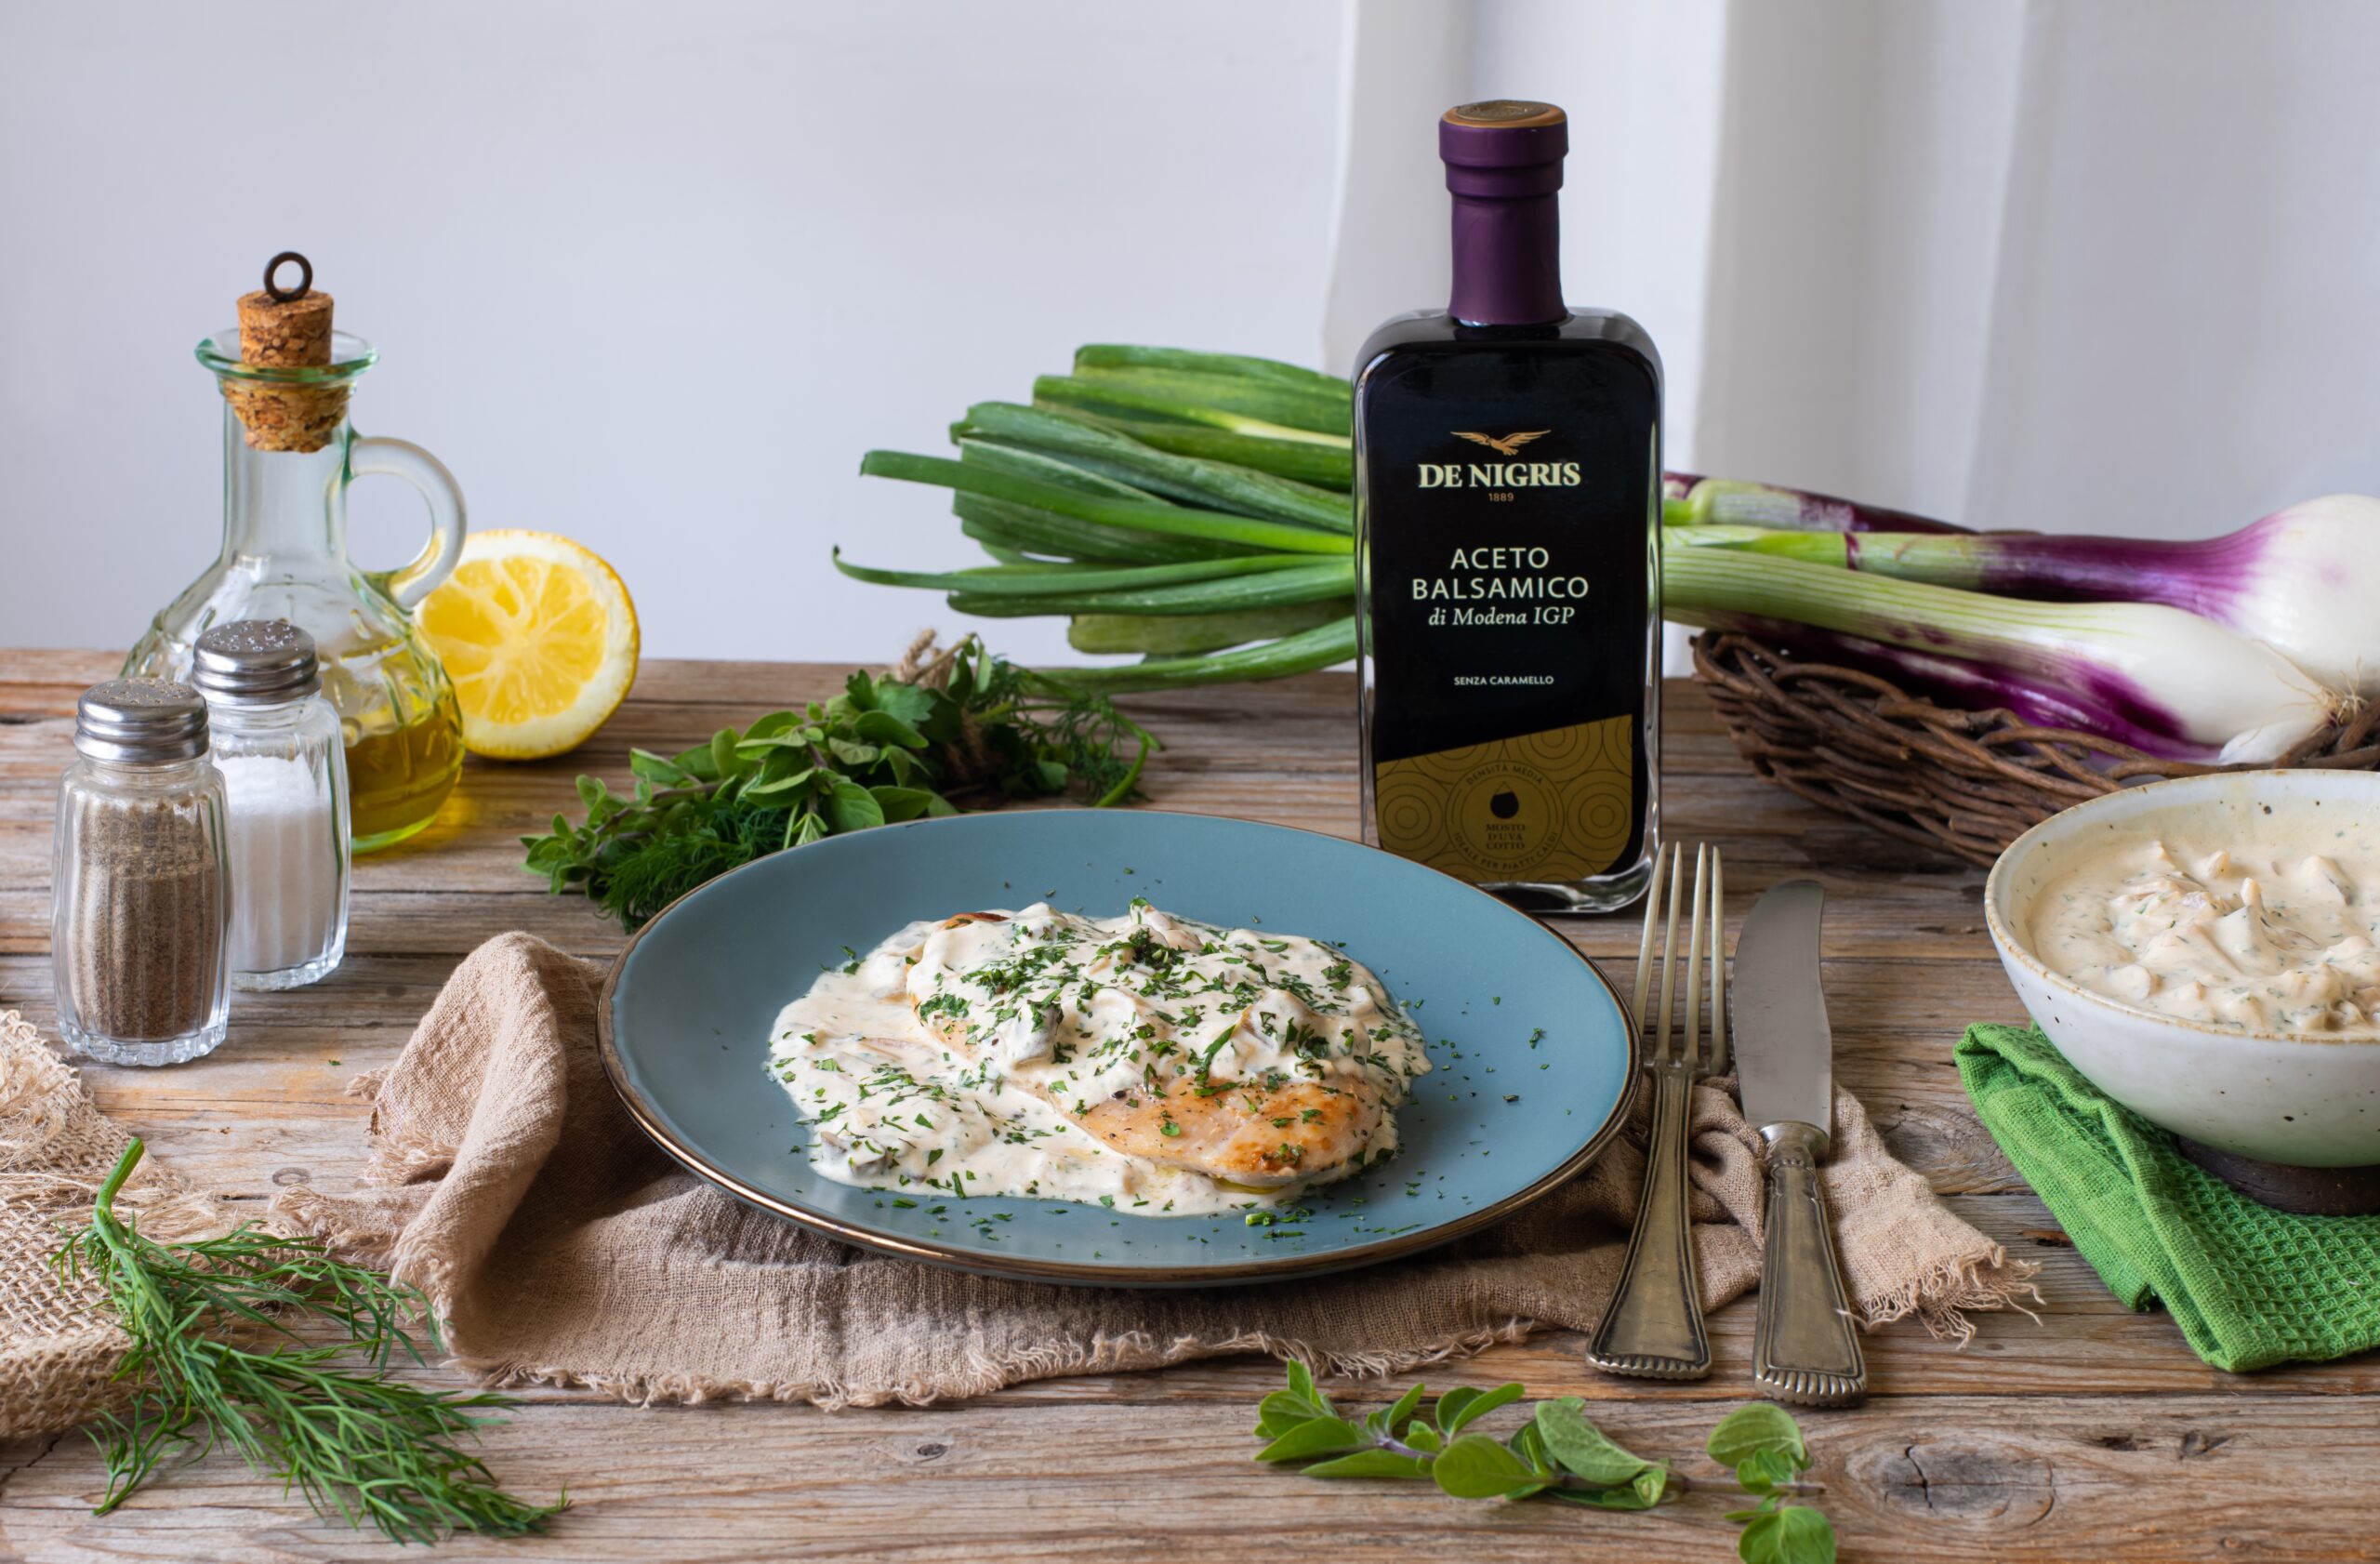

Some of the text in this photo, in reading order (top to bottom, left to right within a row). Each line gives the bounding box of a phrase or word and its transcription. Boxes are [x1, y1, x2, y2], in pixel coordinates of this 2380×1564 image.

[1418, 462, 1581, 487] DE NIGRIS
[1488, 493, 1514, 502] 1889
[1450, 547, 1550, 570] ACETO
[1412, 577, 1589, 600] BALSAMICO
[1428, 606, 1576, 626] di Modena IGP
[1454, 675, 1554, 686] SENZA CARAMELLO
[1466, 762, 1544, 786] DENSITÀ MEDIA
[1486, 824, 1526, 832] MOSTO
[1488, 833, 1524, 842] D'UVA
[1453, 832, 1558, 870] IDEALE PER PIATTI CALDI
[1486, 842, 1526, 851] COTTO
